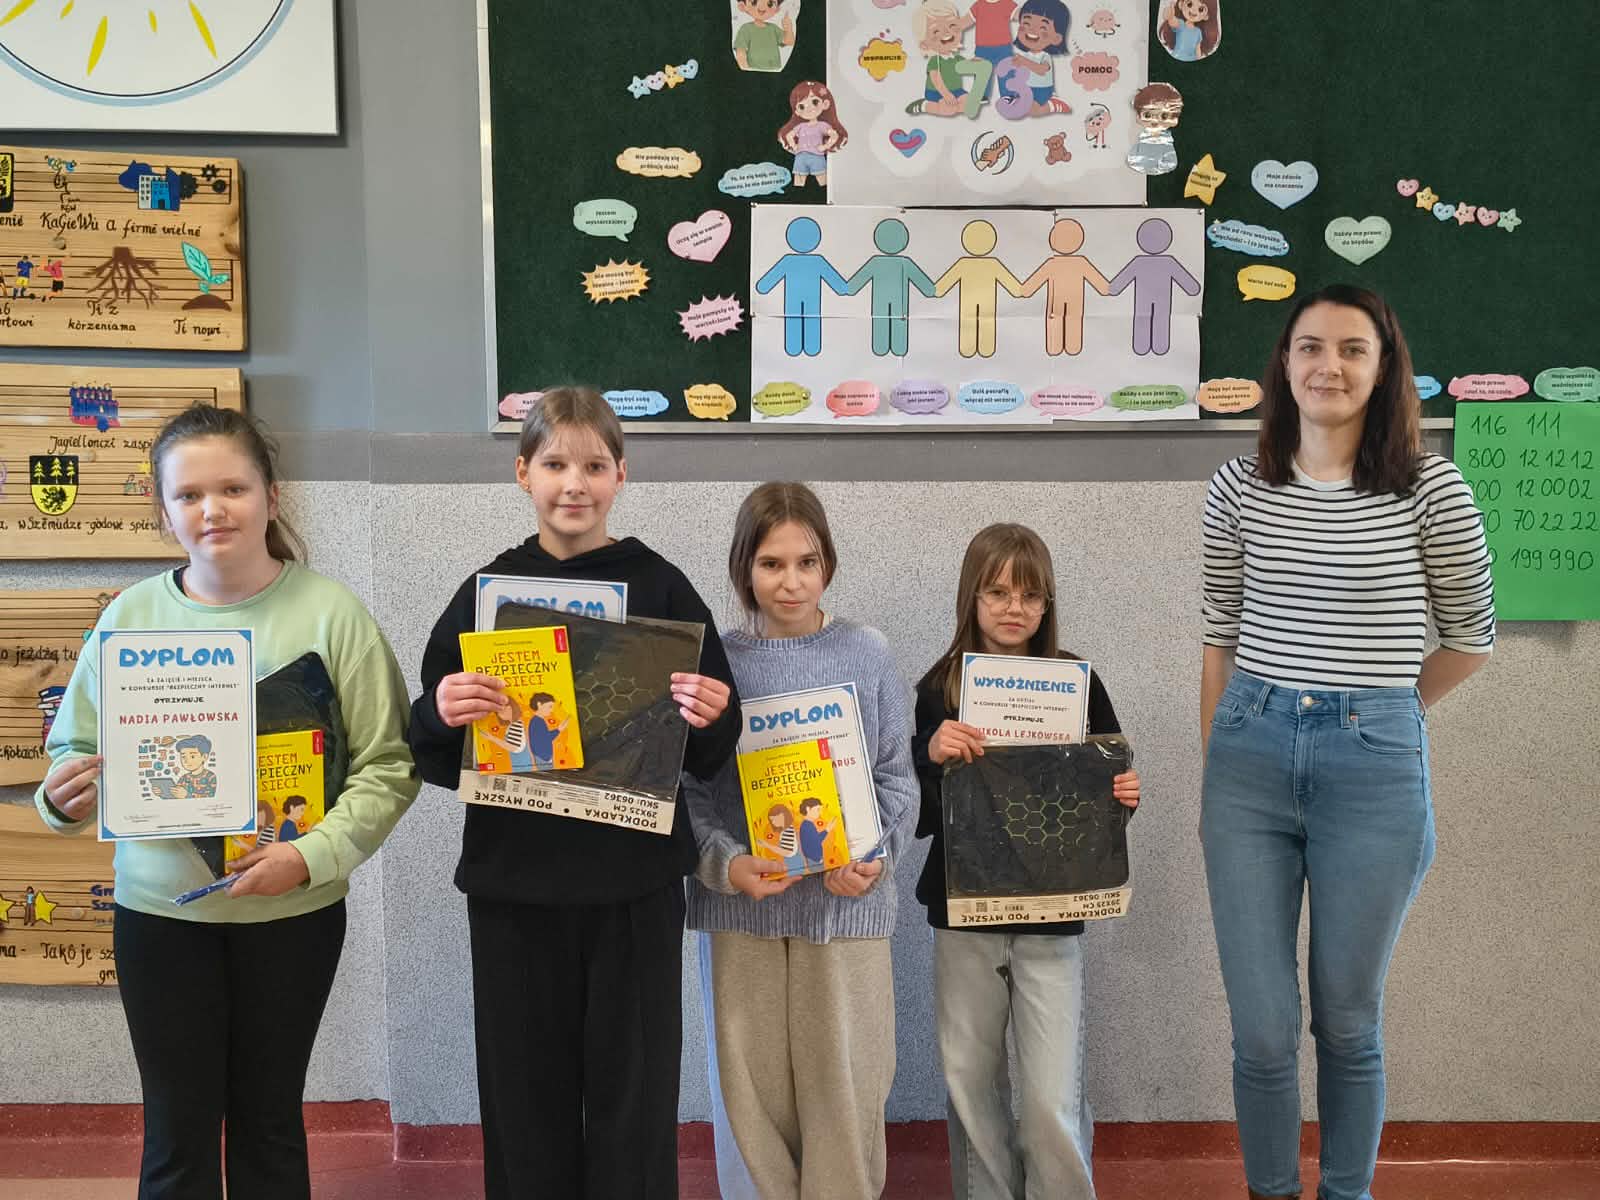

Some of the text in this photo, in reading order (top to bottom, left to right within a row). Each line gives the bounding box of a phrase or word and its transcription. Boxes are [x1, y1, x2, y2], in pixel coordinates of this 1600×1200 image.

[1078, 65, 1113, 76] POMOC
[1470, 411, 1561, 439] 116 111
[1468, 447, 1506, 469] 800
[1512, 509, 1535, 532] 70
[119, 646, 235, 668] DYPLOM
[490, 649, 541, 664] JESTEM
[128, 684, 165, 692] KONKURSIE
[504, 674, 545, 688] SIECI
[973, 676, 1078, 694] WYRÓŻNIENIE
[153, 696, 205, 704] OTRZYMUJE
[119, 711, 239, 725] NADIA PAWŁOWSKA
[749, 702, 843, 733] DYPLOM
[1003, 714, 1046, 724] OTRZYMUJE
[1014, 729, 1072, 742] LEJKOWSKA
[257, 764, 313, 779] PIECZNY
[764, 759, 808, 777] JESTEM
[261, 776, 299, 793] SIECI
[751, 767, 825, 791] BEZPIECZNY
[603, 791, 635, 804] 06362
[775, 781, 813, 798] SIECI
[474, 790, 657, 830] PODKŁADKA POD MYSZKĘ
[637, 797, 660, 809] SKU:
[961, 906, 1122, 924] PODKŁADKA POD MYSZKĘ
